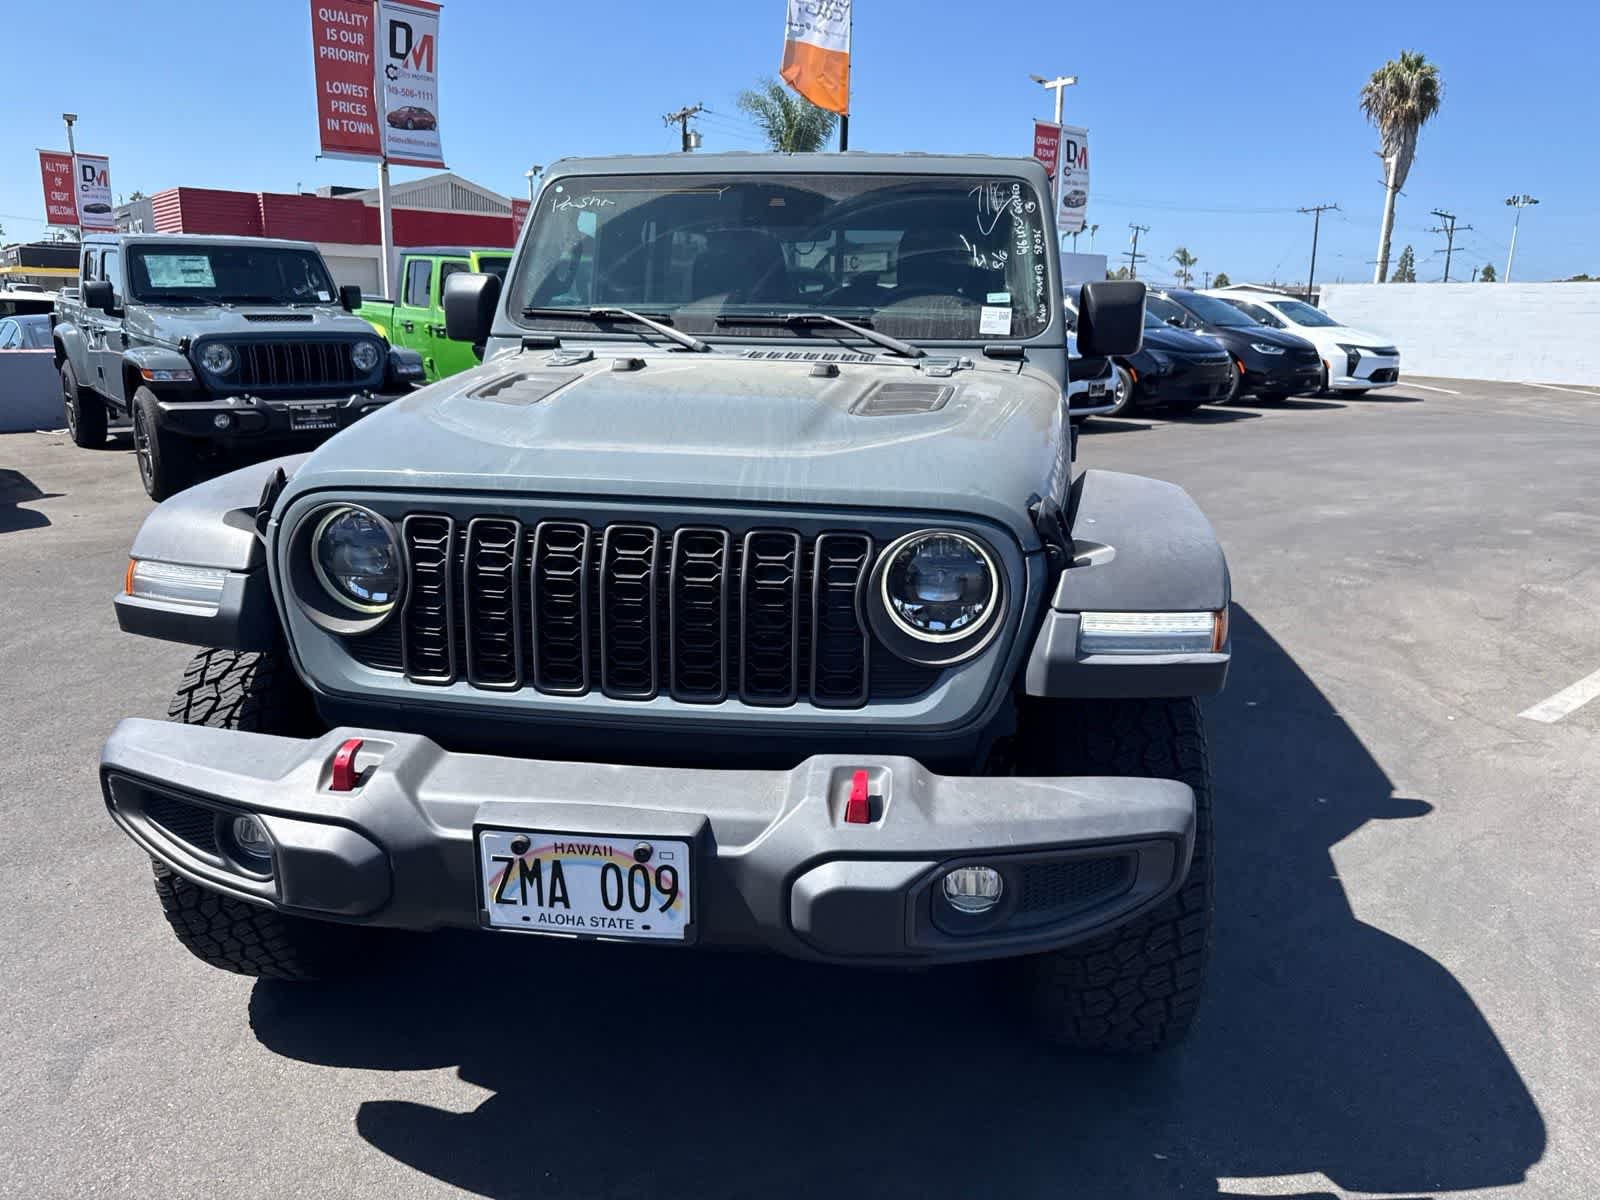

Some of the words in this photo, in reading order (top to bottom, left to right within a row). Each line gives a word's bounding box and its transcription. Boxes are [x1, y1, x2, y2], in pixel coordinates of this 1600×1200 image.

[318, 8, 368, 28] QUALITY
[326, 28, 337, 40] IS
[340, 30, 364, 45] OUR
[389, 19, 434, 73] DM
[319, 47, 370, 66] PRIORITY
[326, 81, 368, 98] LOWEST
[331, 100, 367, 116] PRICES
[327, 119, 339, 131] IN
[341, 120, 374, 135] TOWN
[1036, 136, 1058, 146] QUALITY
[45, 162, 55, 173] ALL
[55, 163, 70, 174] TYPE
[54, 178, 63, 187] OF
[51, 192, 69, 201] CREDIT
[48, 205, 76, 216] WELCOME
[554, 842, 613, 857] HAWAII
[492, 856, 571, 909] ZMA
[600, 862, 679, 913] 009
[538, 912, 585, 926] ALOHA
[590, 916, 635, 930] STATE
